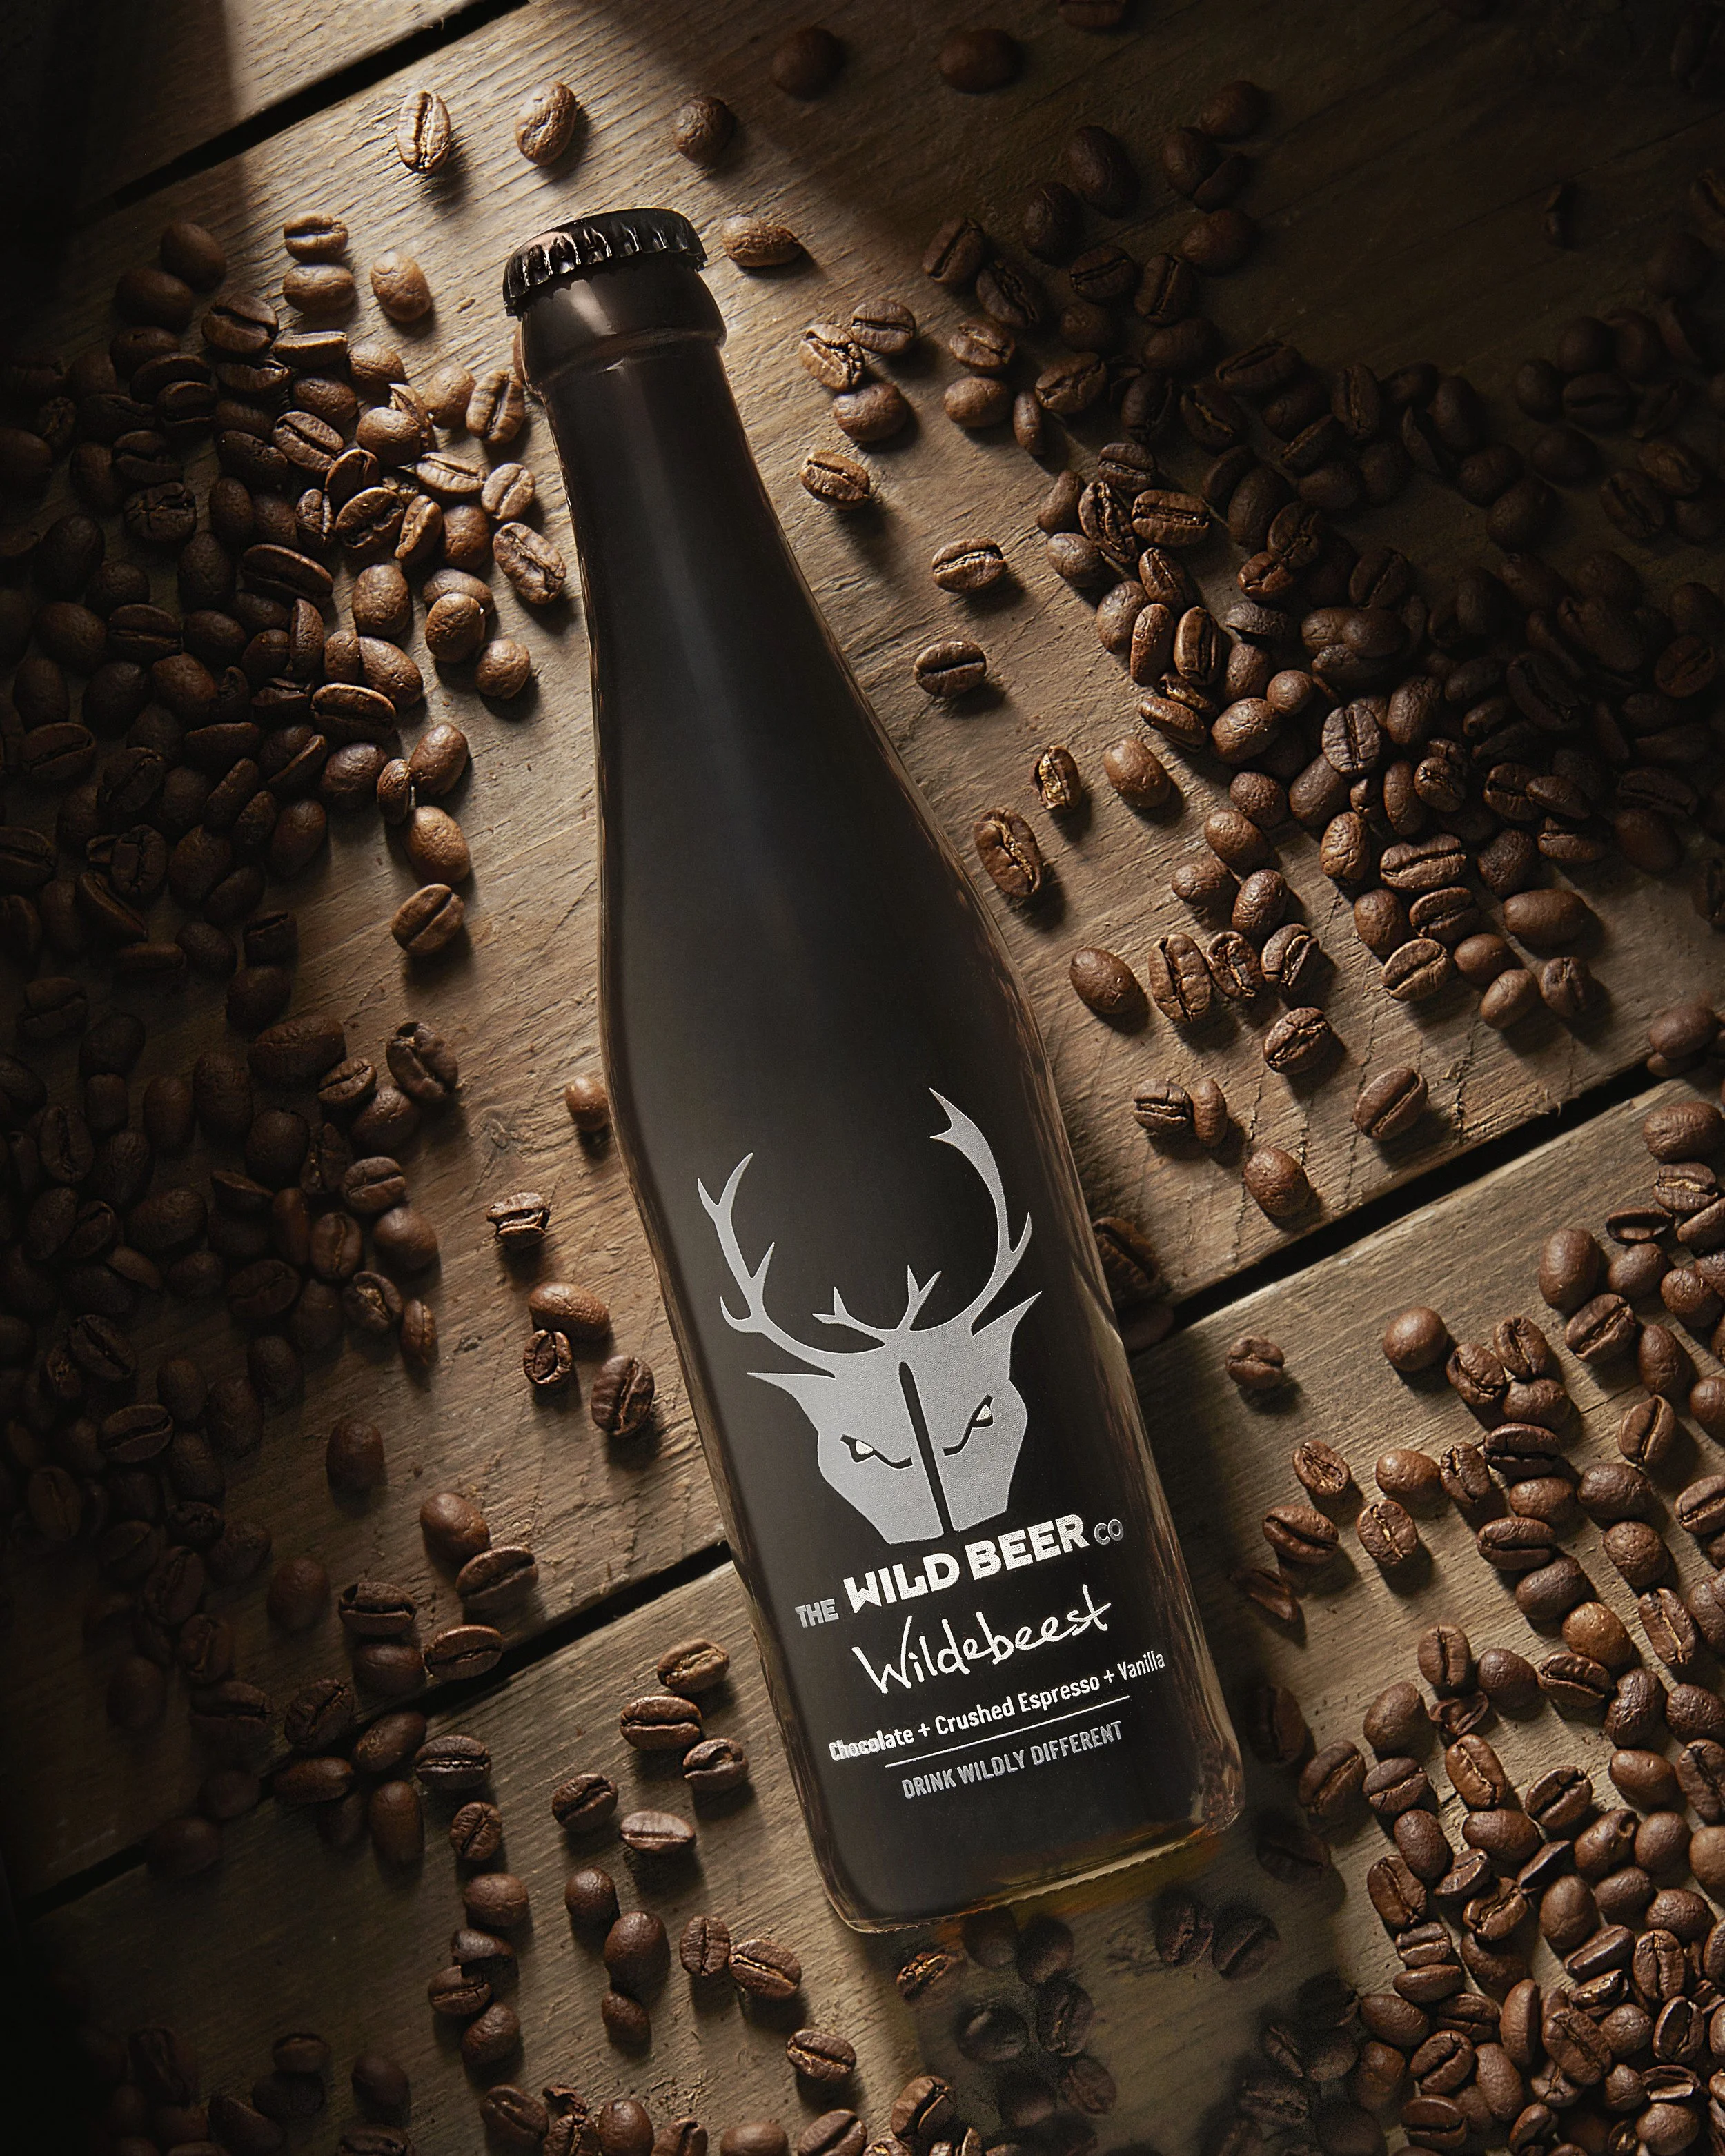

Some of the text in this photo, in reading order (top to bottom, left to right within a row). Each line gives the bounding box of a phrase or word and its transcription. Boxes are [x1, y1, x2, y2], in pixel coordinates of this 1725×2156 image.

[795, 1514, 1124, 1628] THE WILD BEER CO
[852, 1585, 1111, 1694] Wildebeest
[829, 1651, 1165, 1761] Chocolate + Crushed Espresso + Vanilla
[902, 1721, 1122, 1799] DRINK WILDLY DIFFERENT
